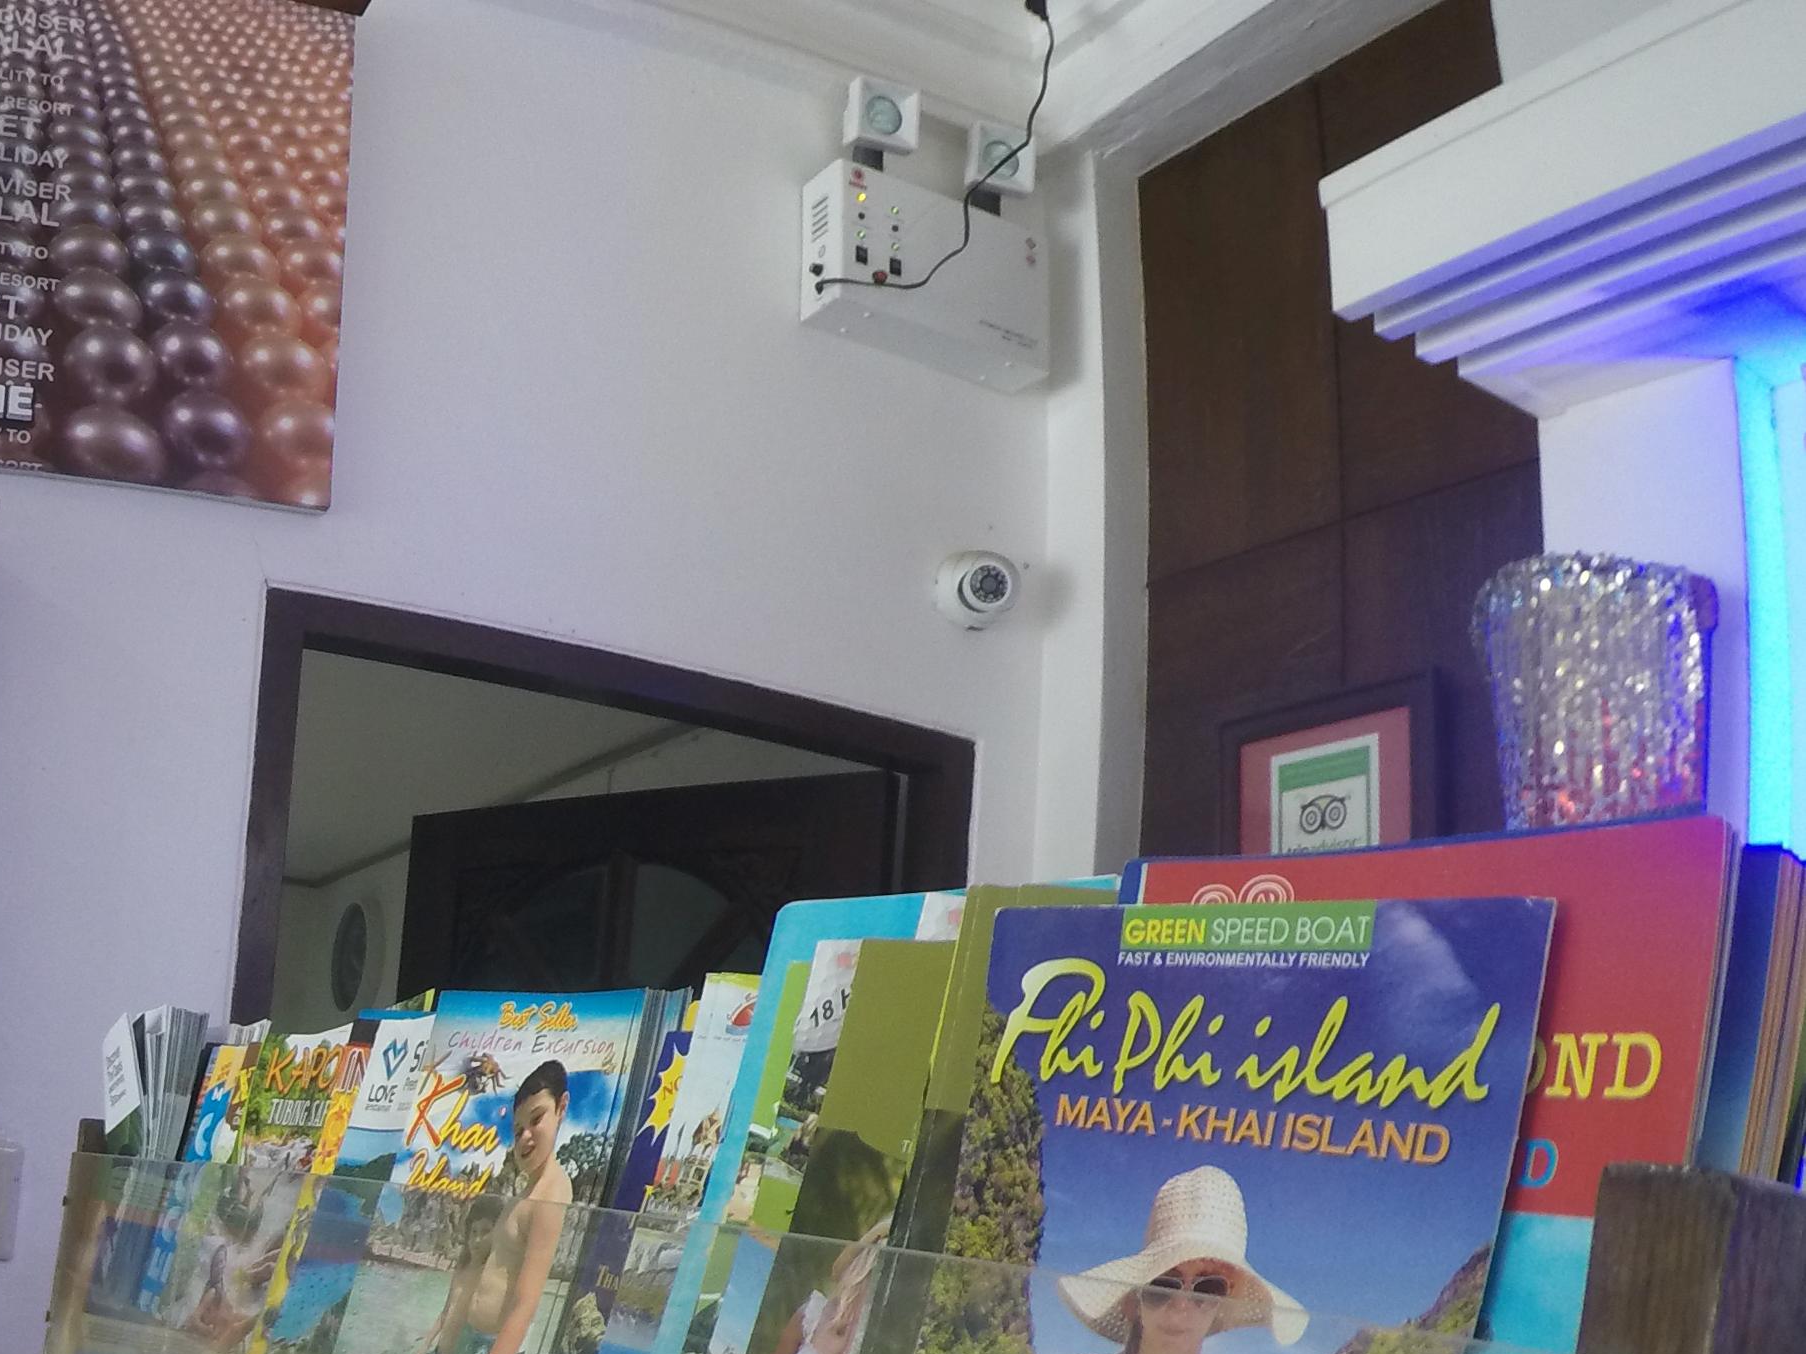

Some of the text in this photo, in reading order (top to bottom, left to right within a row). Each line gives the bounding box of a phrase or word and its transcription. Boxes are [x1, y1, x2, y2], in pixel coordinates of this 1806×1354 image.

[40, 71, 65, 88] TO
[3, 94, 75, 117] RESORT
[6, 427, 33, 445] TO
[1124, 912, 1373, 947] GREEN SPEED BOAT
[1117, 949, 1371, 970] FAST & ENVIRONMENTALLY FRIENDLY
[500, 1001, 580, 1032] Best Seller
[809, 999, 835, 1029] 18
[447, 1028, 616, 1066] Children Excursion
[991, 957, 1502, 1109] Phi Phi island
[367, 1083, 398, 1105] LOVE
[267, 1097, 311, 1126] TUBING
[405, 1072, 502, 1154] Khai
[1054, 1093, 1452, 1167] MAYA KHAI ISLAND
[408, 1147, 496, 1201] Island
